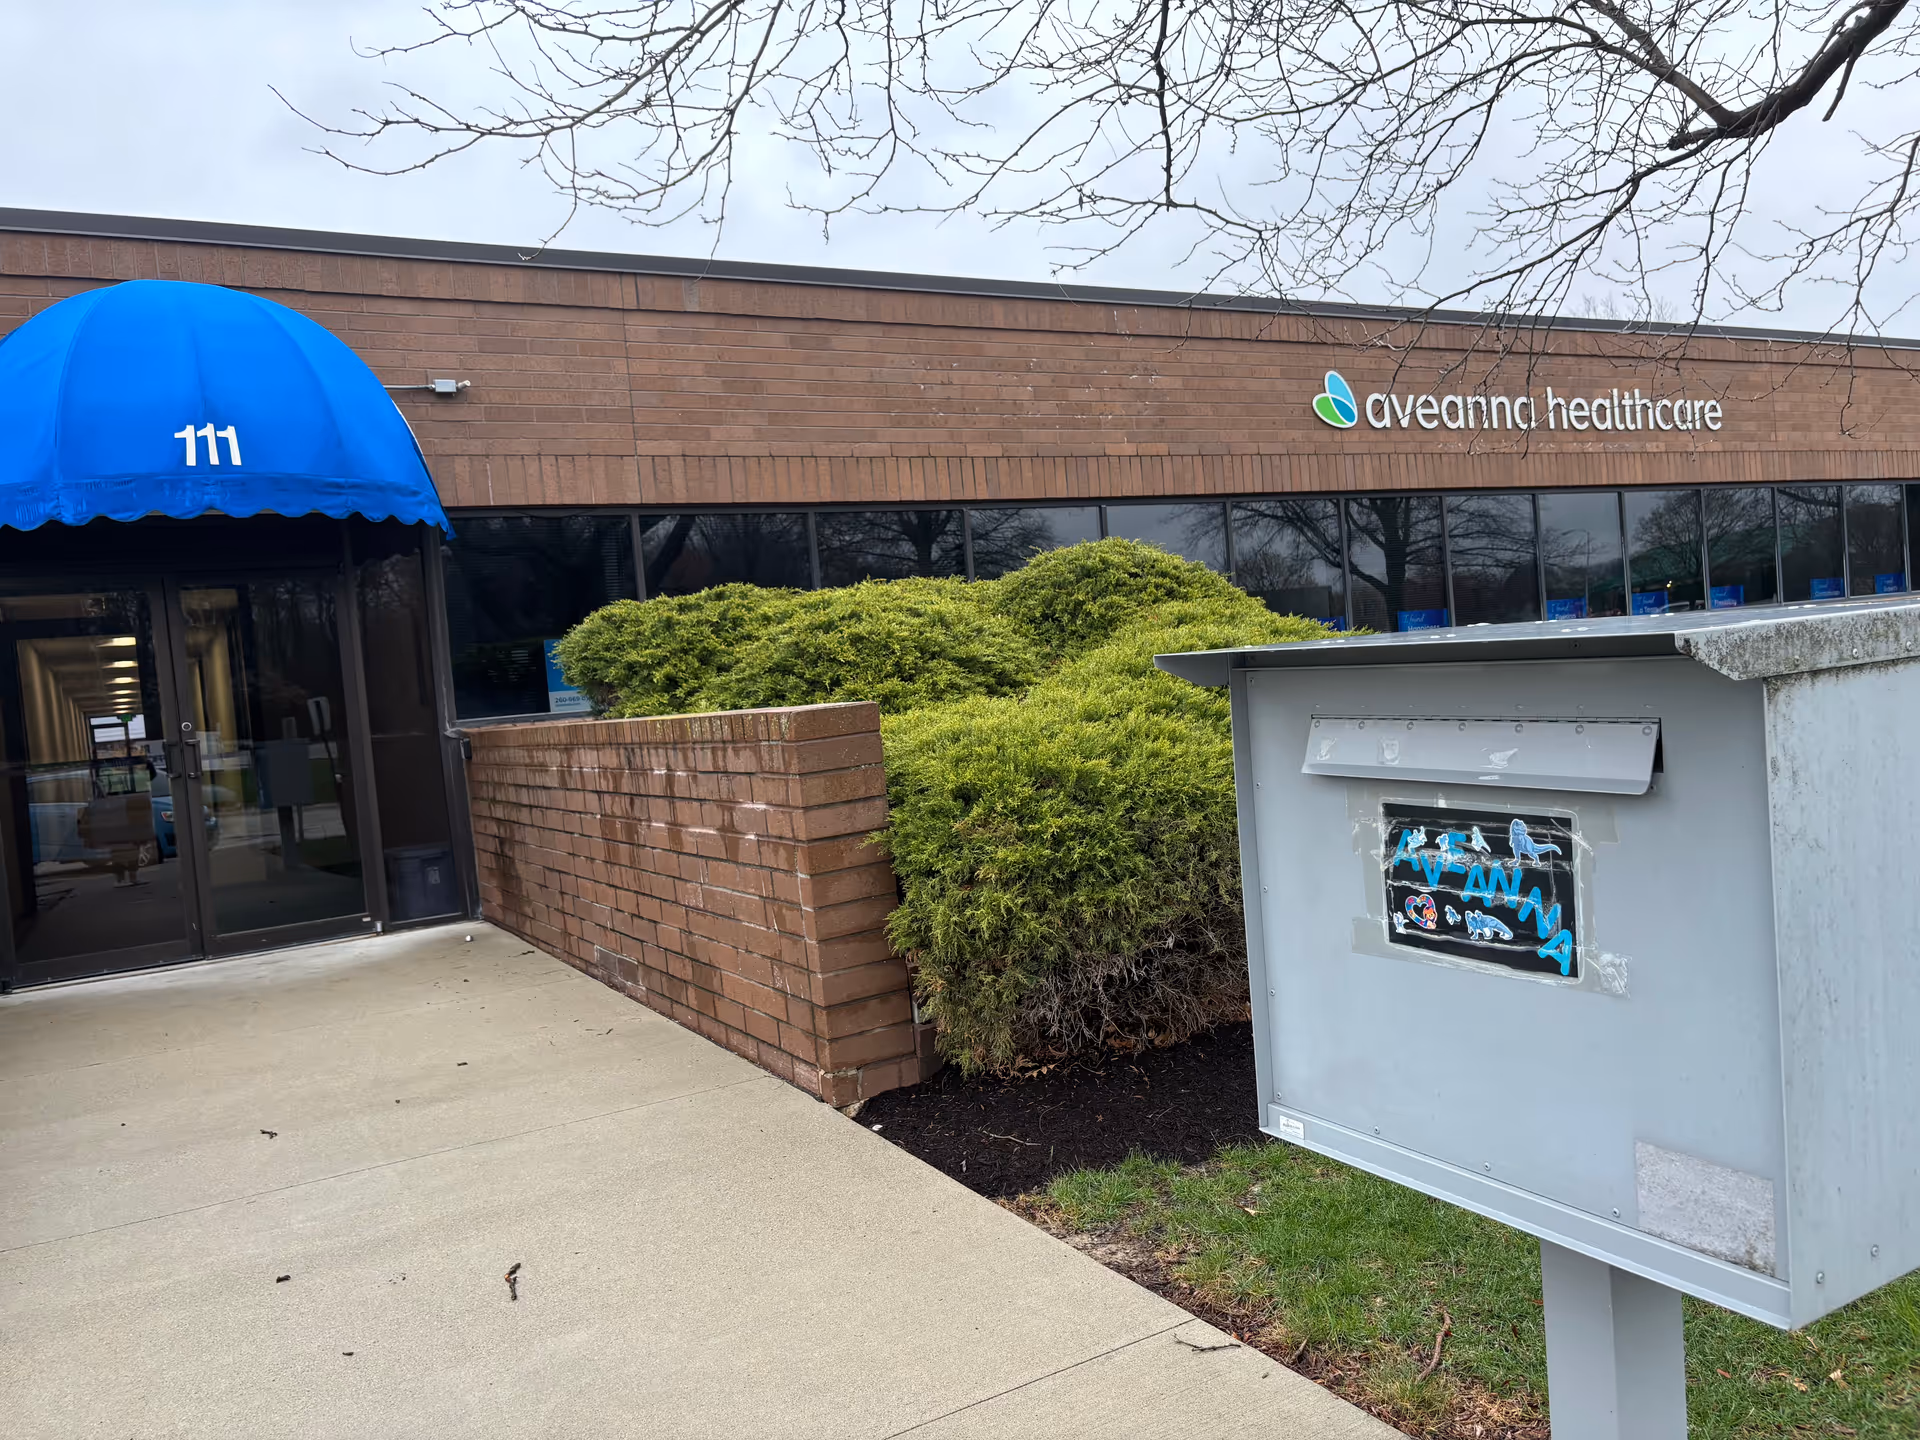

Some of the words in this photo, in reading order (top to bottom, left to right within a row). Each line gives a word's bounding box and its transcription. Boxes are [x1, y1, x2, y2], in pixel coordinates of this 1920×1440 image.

[1365, 391, 1537, 430] aveanna
[1547, 386, 1723, 432] healthcare
[174, 422, 242, 467] 111
